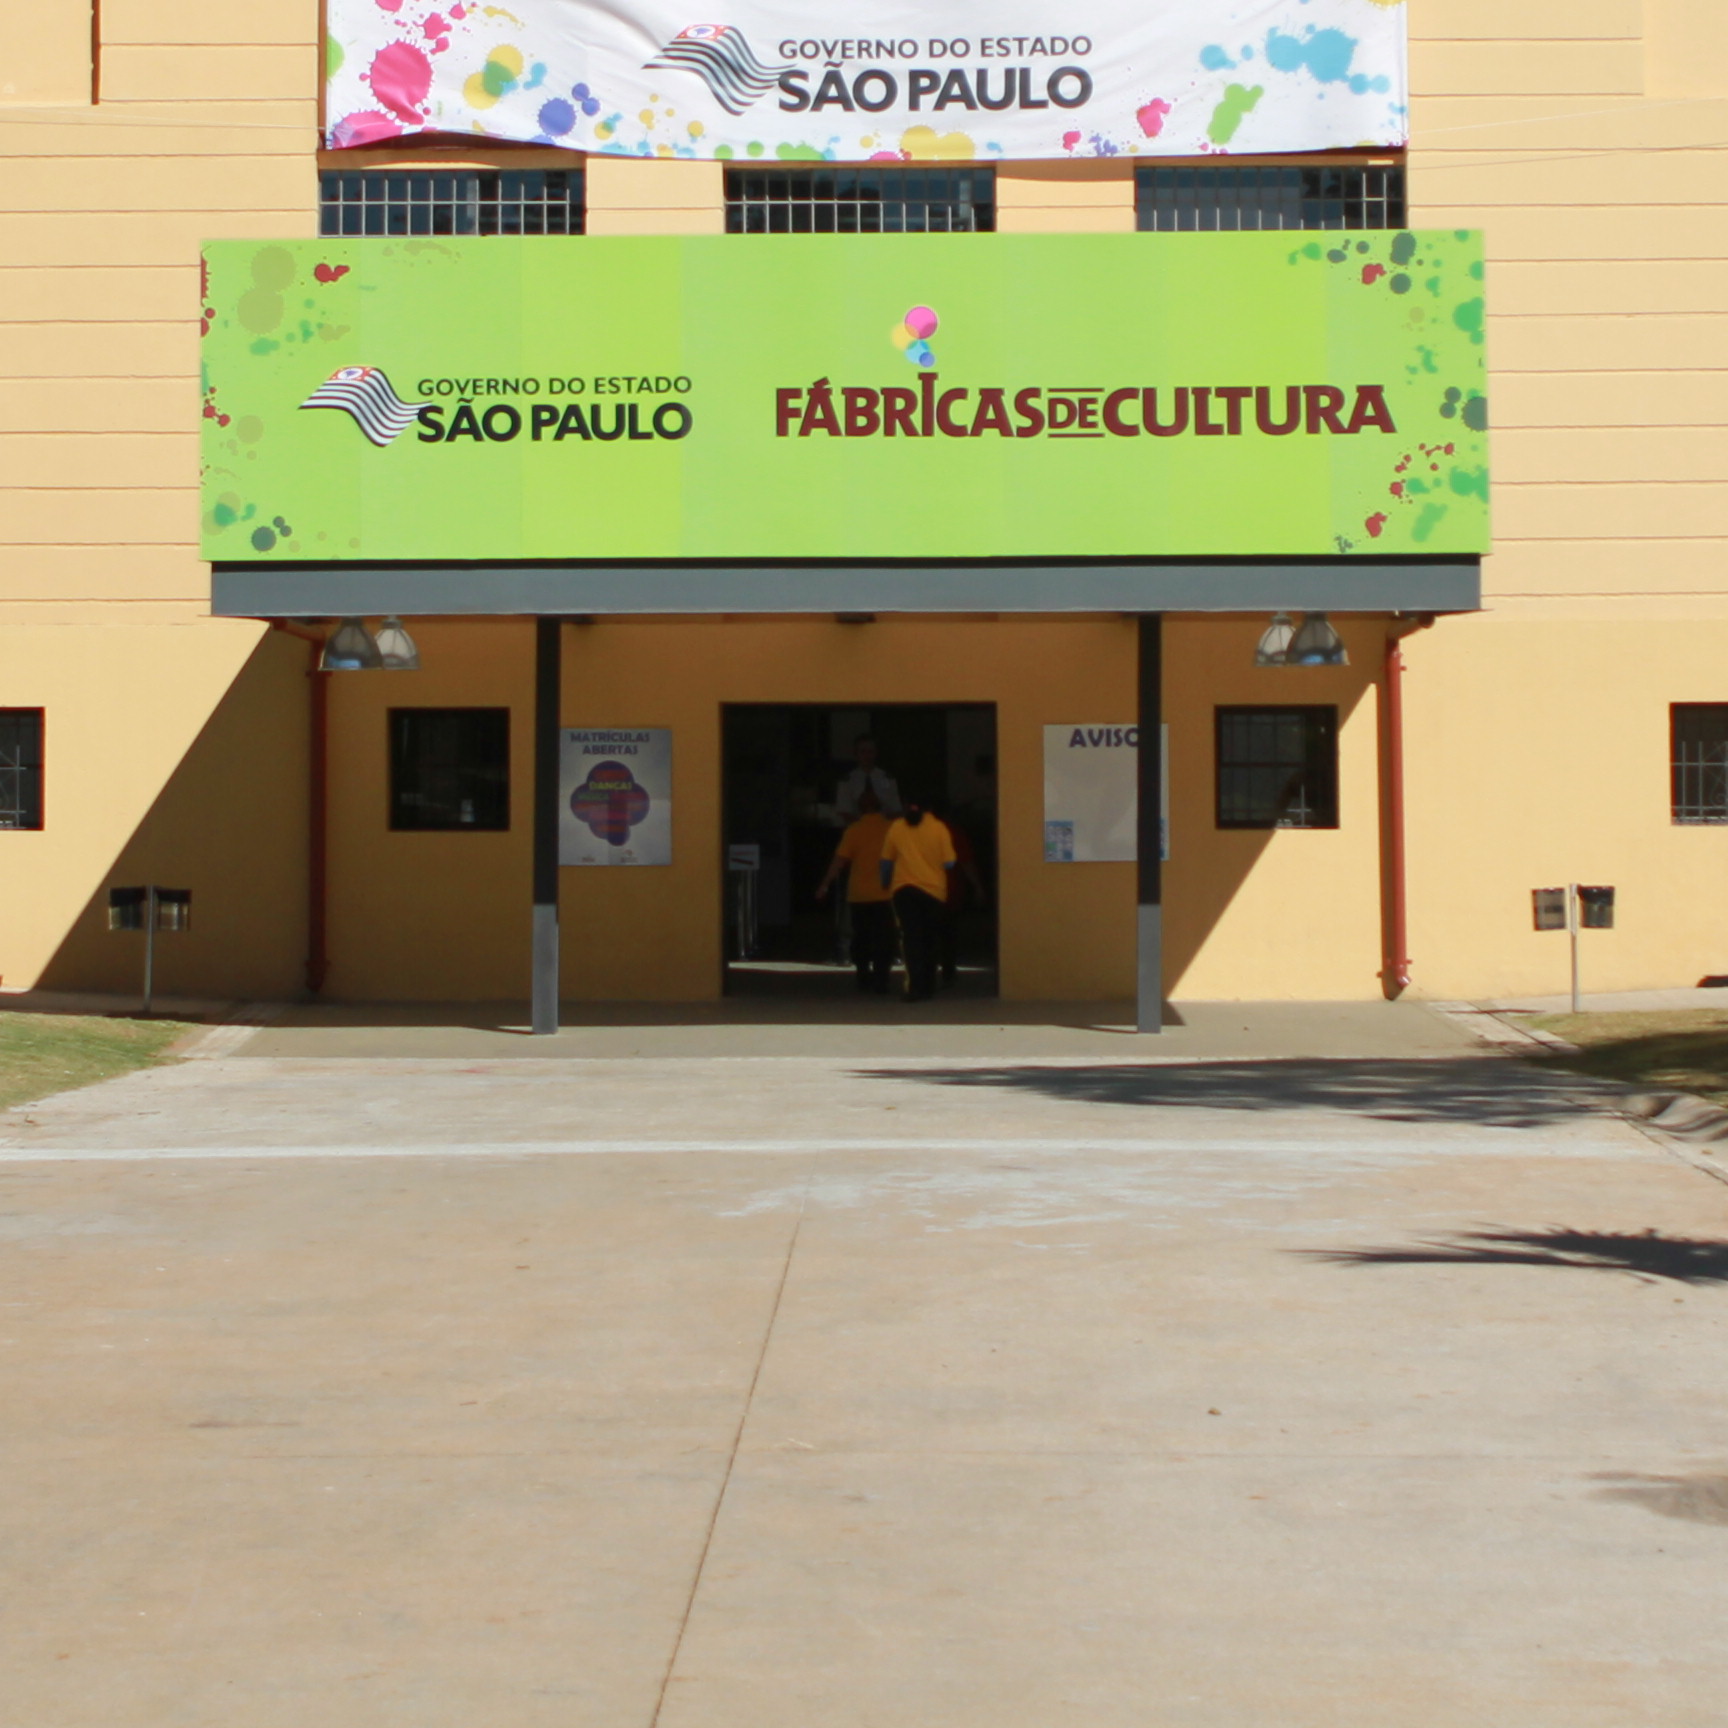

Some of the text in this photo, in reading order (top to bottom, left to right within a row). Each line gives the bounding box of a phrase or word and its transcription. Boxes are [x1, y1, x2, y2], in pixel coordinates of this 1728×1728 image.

[778, 35, 1093, 60] GOVERNO DO ESTADO
[778, 61, 1094, 113] SÃO PAULO
[417, 375, 693, 396] GOVERNO DO ESTADO
[417, 397, 694, 443] SÃO PAULO
[775, 371, 1047, 439] FÁBRICAS
[1102, 384, 1398, 437] CULTURA
[583, 745, 638, 755] ABERTAS
